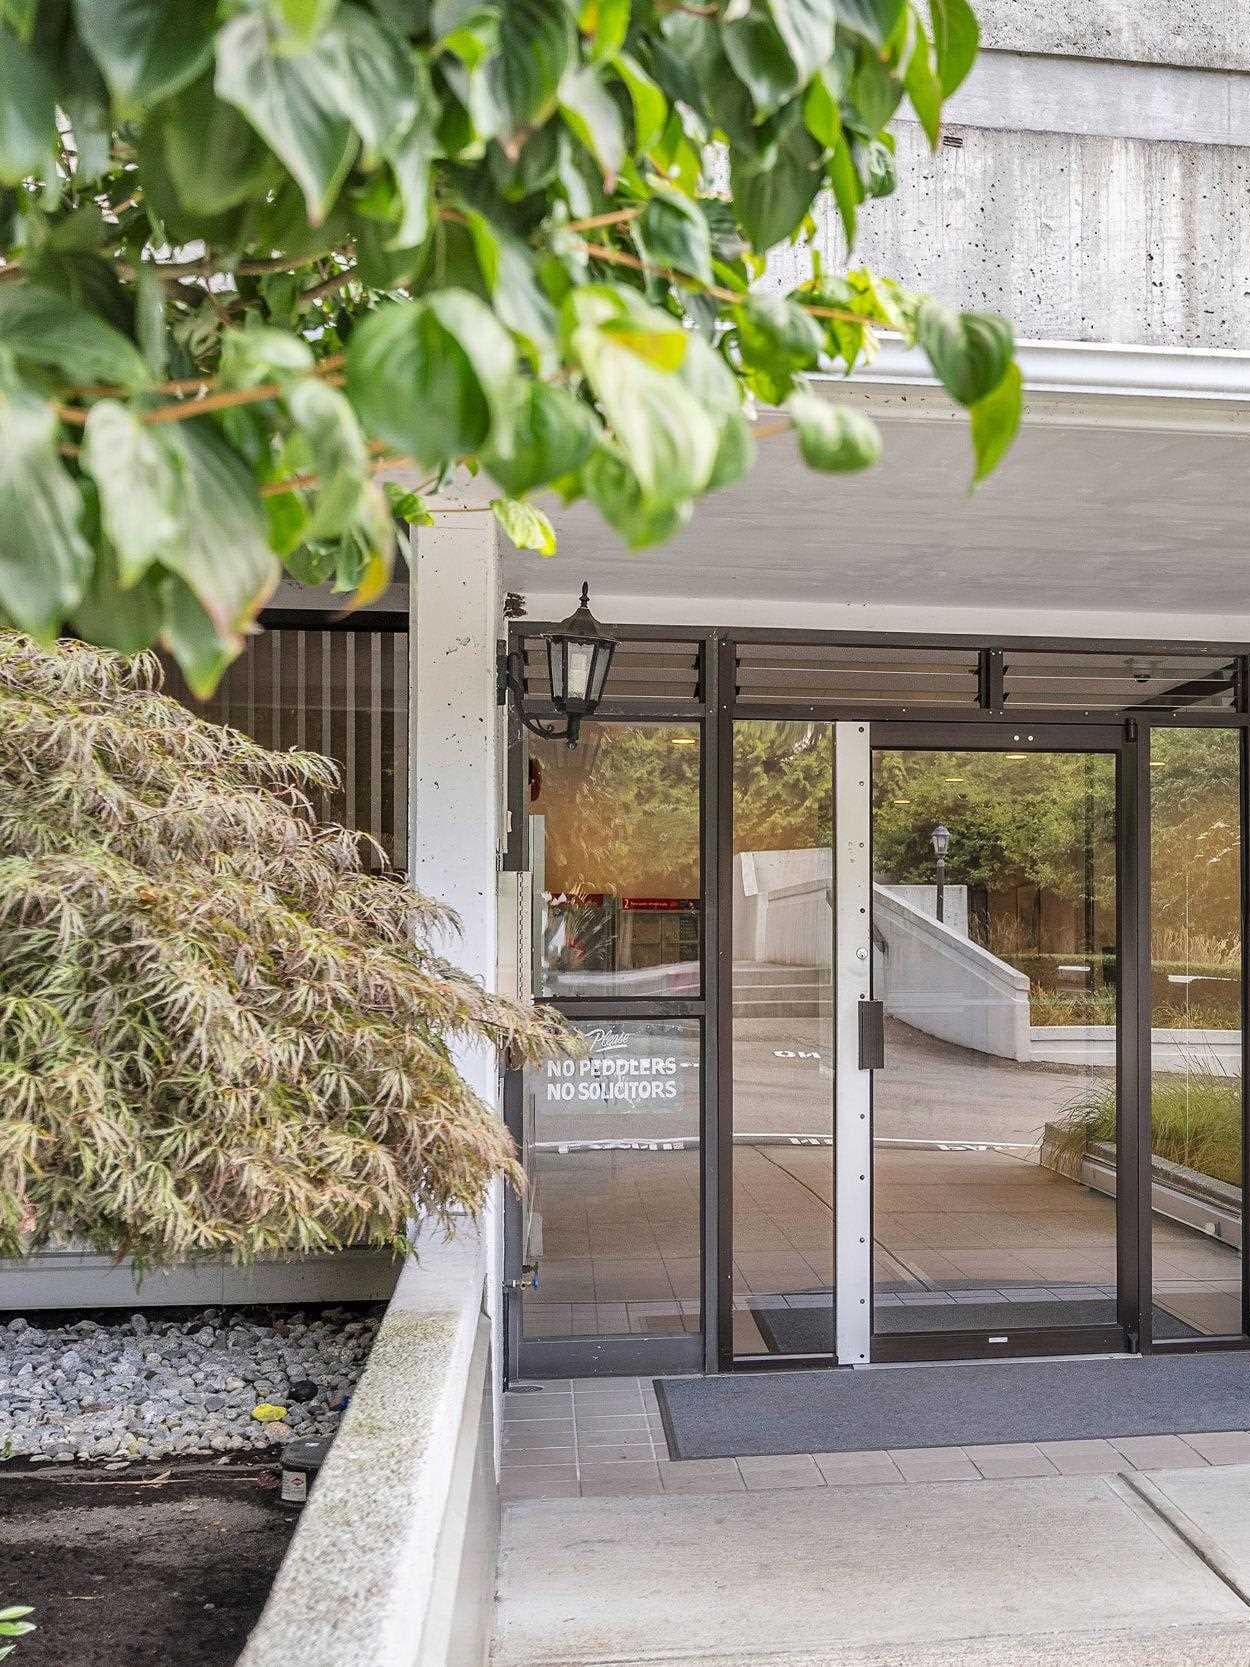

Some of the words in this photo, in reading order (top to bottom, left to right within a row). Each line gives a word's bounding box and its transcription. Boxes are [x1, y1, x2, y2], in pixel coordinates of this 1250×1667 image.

[585, 1028, 631, 1052] Please
[547, 1059, 576, 1077] NO
[579, 1057, 677, 1076] PEDDLERS
[547, 1083, 576, 1100] NO
[577, 1080, 677, 1100] SOLICITORS
